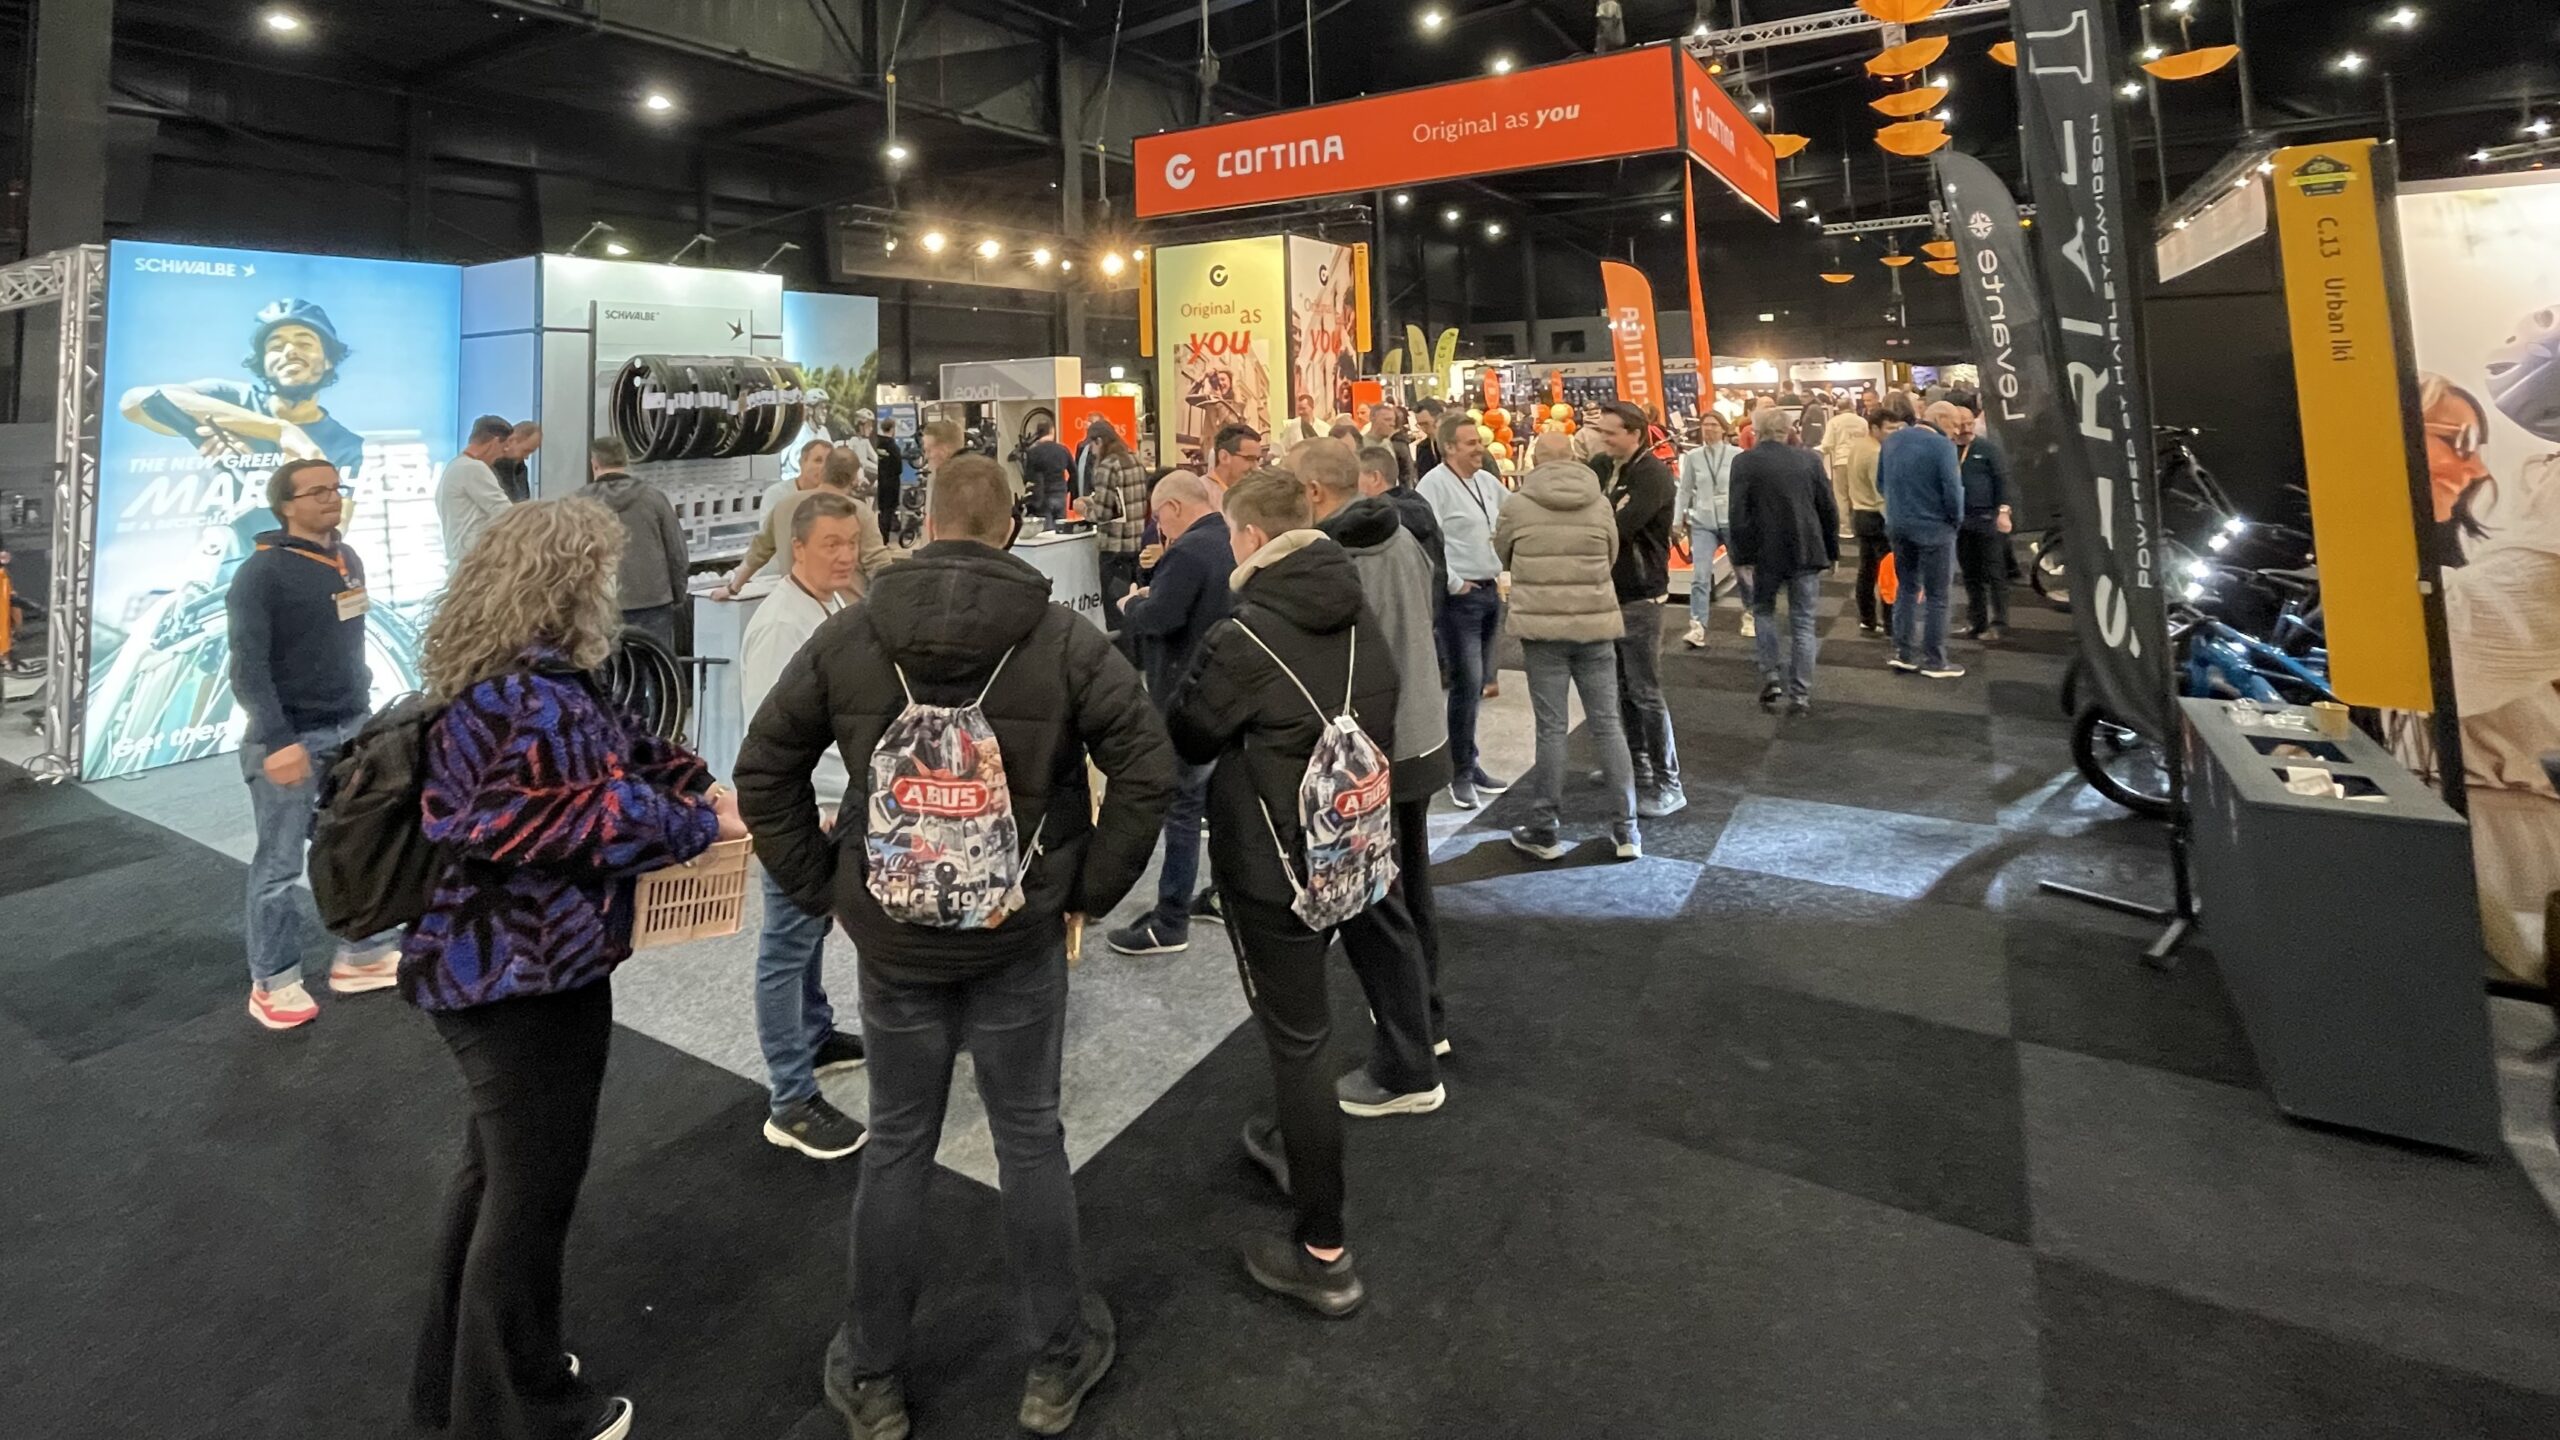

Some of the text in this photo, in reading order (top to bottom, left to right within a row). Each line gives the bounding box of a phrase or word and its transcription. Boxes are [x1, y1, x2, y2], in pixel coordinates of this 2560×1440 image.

[1412, 103, 1581, 143] Original as you
[1217, 135, 1345, 178] CORTINA
[2317, 217, 2341, 259] C.13
[134, 257, 238, 277] SCHWALBE
[605, 309, 656, 321] SCHWALBE
[1180, 300, 1262, 324] Original as
[2324, 277, 2347, 334] Urban
[1187, 330, 1251, 365] you
[1311, 329, 1343, 361] you
[2329, 339, 2356, 362] Iki
[129, 452, 286, 473] THE NEW GREEN
[2125, 440, 2154, 589] POWERED
[112, 731, 165, 758] Get
[902, 784, 977, 808] ABUS
[1344, 780, 1389, 812] ABUS
